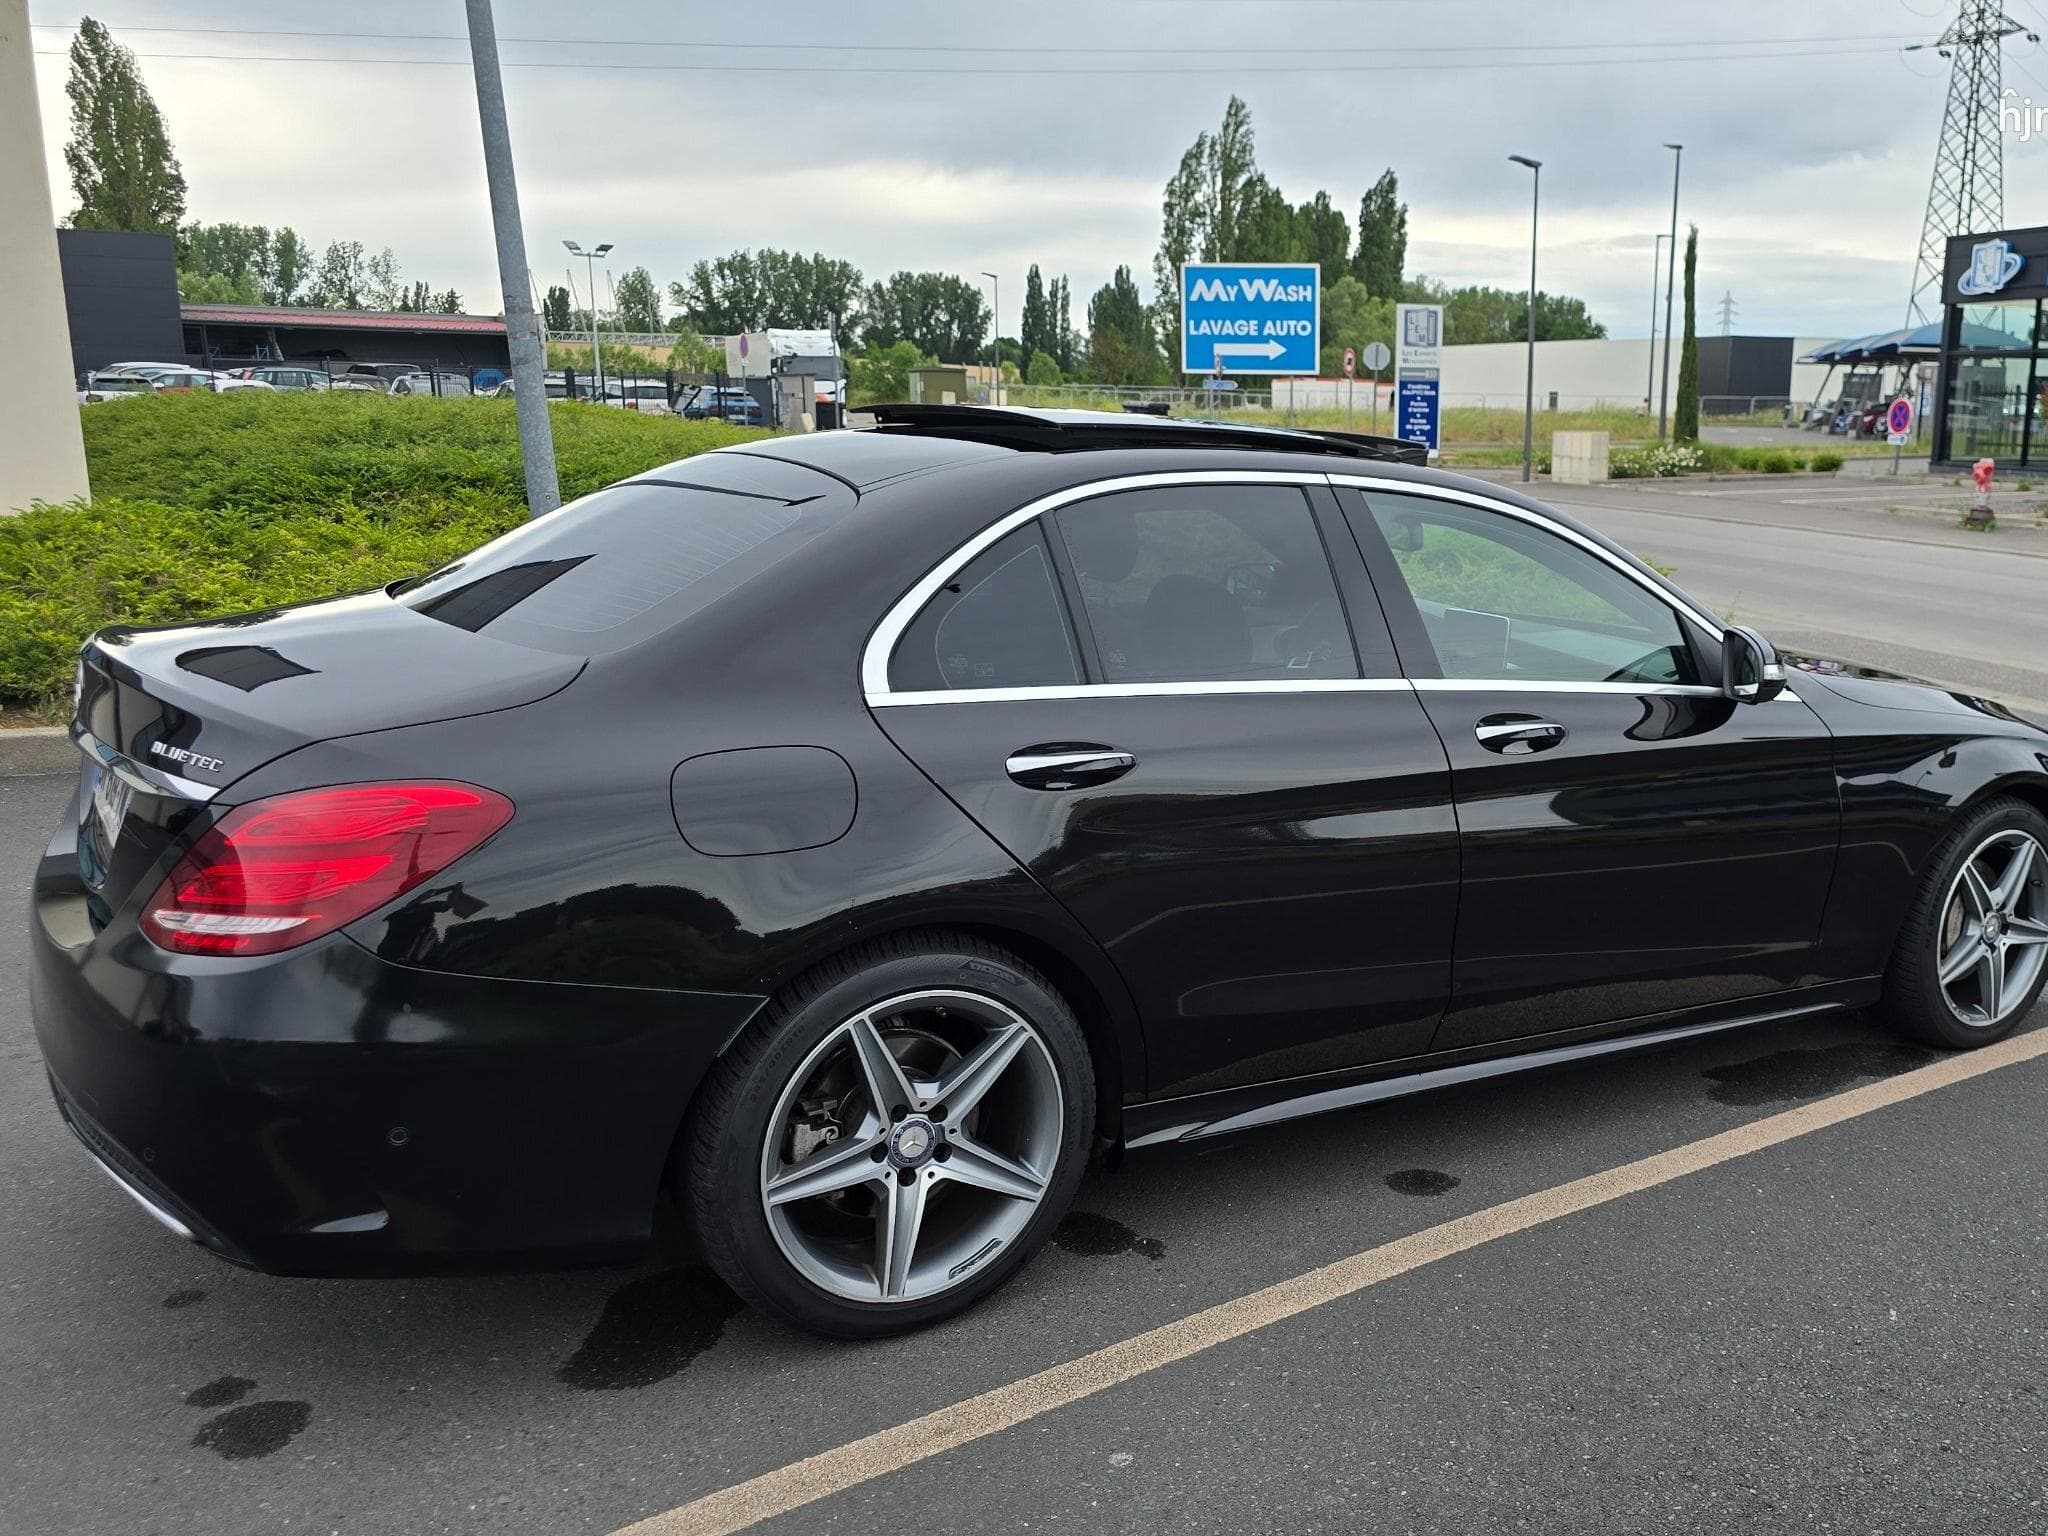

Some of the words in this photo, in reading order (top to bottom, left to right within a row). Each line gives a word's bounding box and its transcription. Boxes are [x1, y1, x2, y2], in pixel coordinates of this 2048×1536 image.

[1189, 319, 1258, 335] LAVAGE
[1263, 319, 1312, 336] AUTO
[151, 741, 224, 772] BLUETEC
